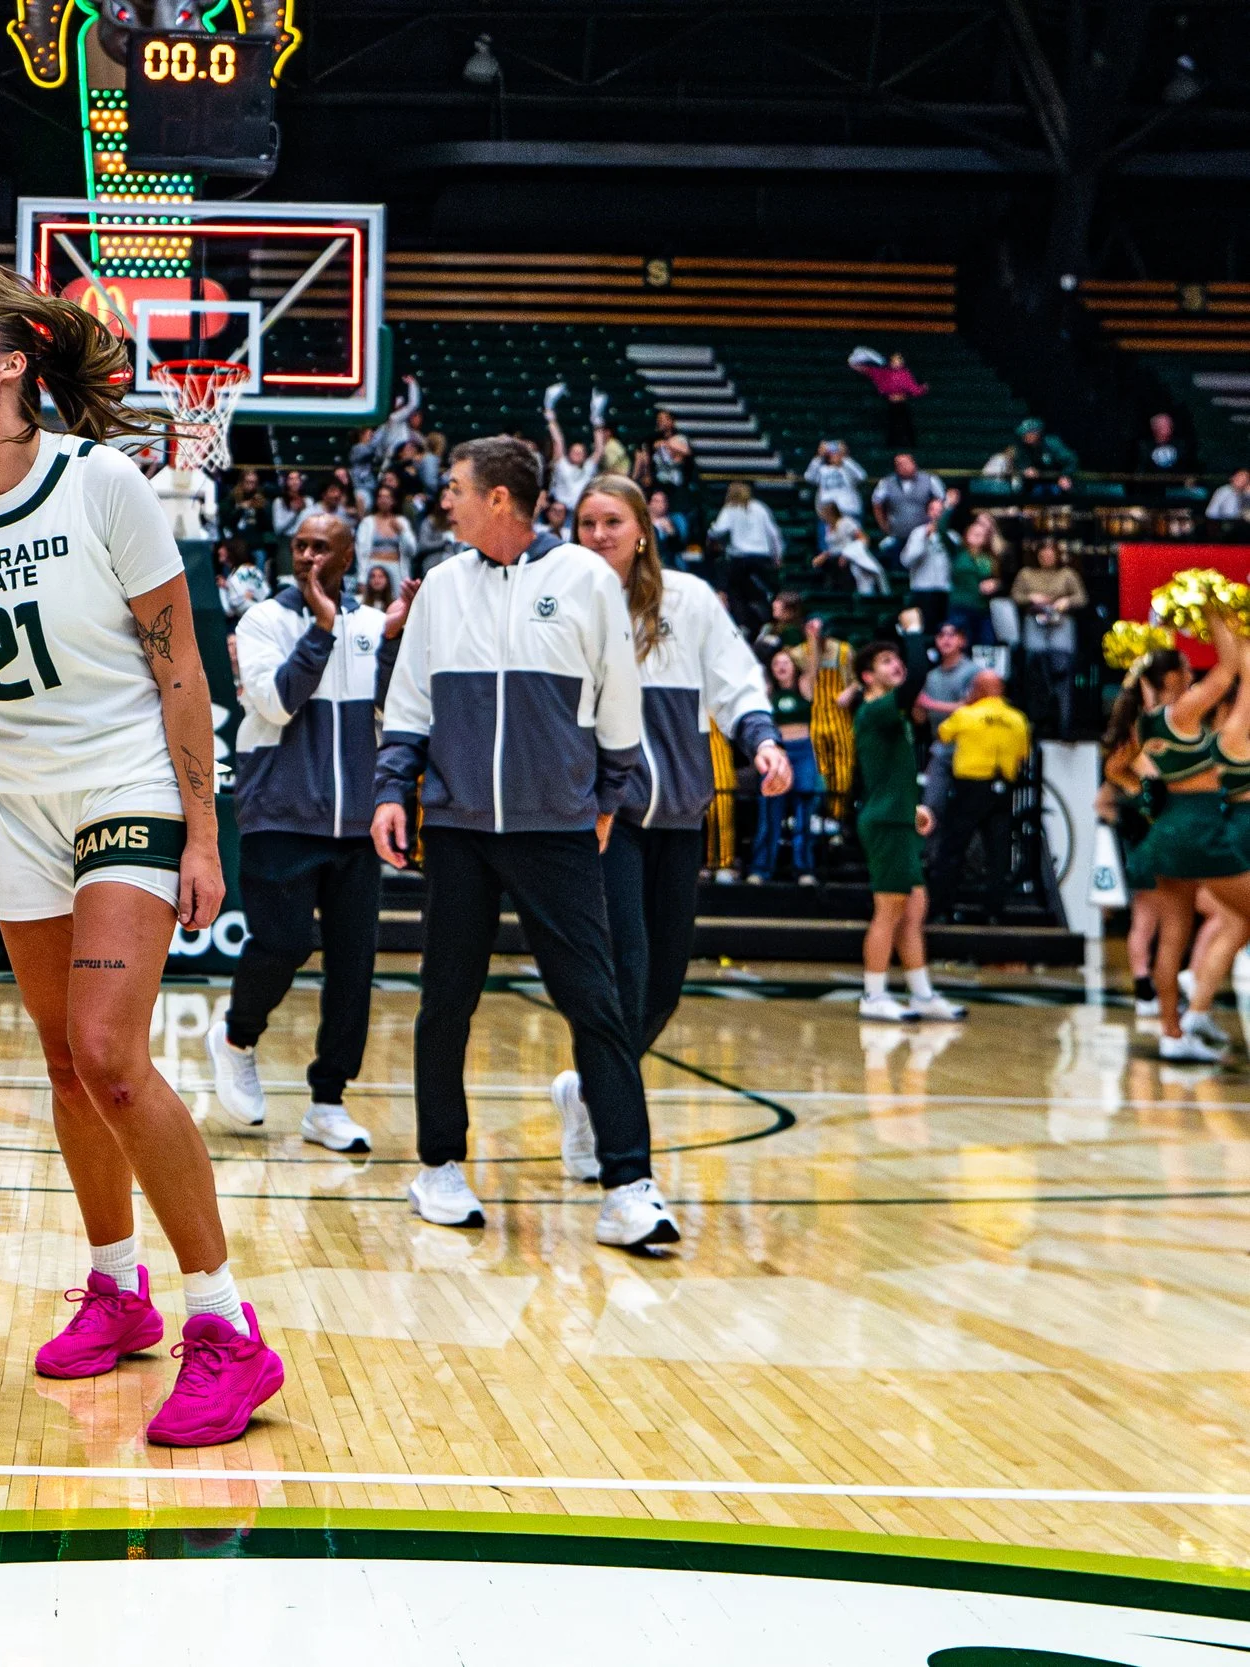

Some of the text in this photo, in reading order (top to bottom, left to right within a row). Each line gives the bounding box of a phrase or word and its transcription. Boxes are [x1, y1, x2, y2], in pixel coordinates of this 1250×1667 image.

[144, 41, 235, 83] 00.0
[647, 260, 669, 286] S
[74, 825, 149, 865] RAMS
